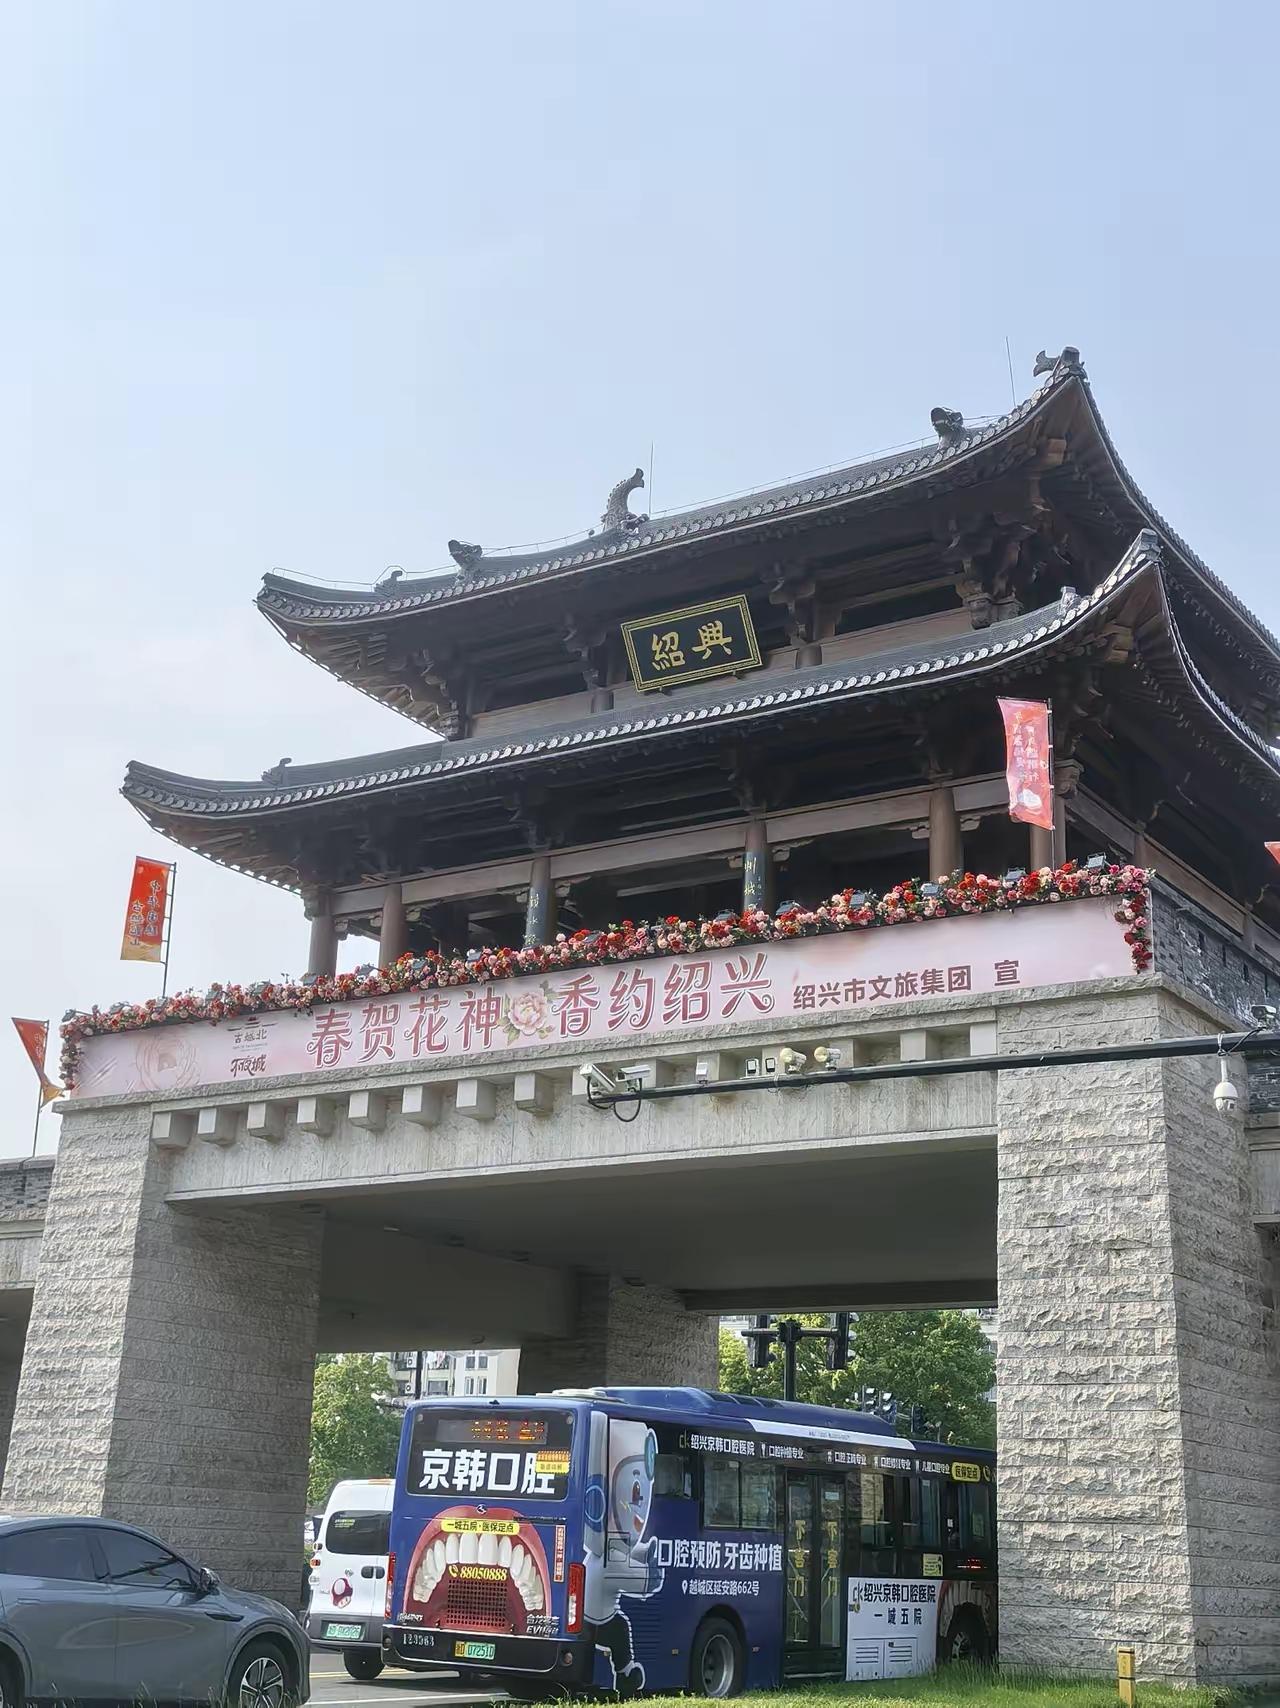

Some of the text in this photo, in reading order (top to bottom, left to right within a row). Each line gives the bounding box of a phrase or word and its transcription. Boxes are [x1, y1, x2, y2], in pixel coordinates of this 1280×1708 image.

[793, 960, 1020, 1010] 绍兴市文旅集团 宣
[306, 953, 776, 1068] 春贺花神 香约绍兴
[690, 1434, 755, 1457] 绍兴京韩口腔医院
[419, 1449, 555, 1495] 京韩口腔
[658, 1539, 782, 1571] 口腔预防 牙齿种植
[460, 1566, 508, 1581] 88050888
[689, 1579, 760, 1596] 越城区延安路662号
[863, 1583, 936, 1604] 绍兴京韩口腔医院
[874, 1607, 922, 1625] 一城五院
